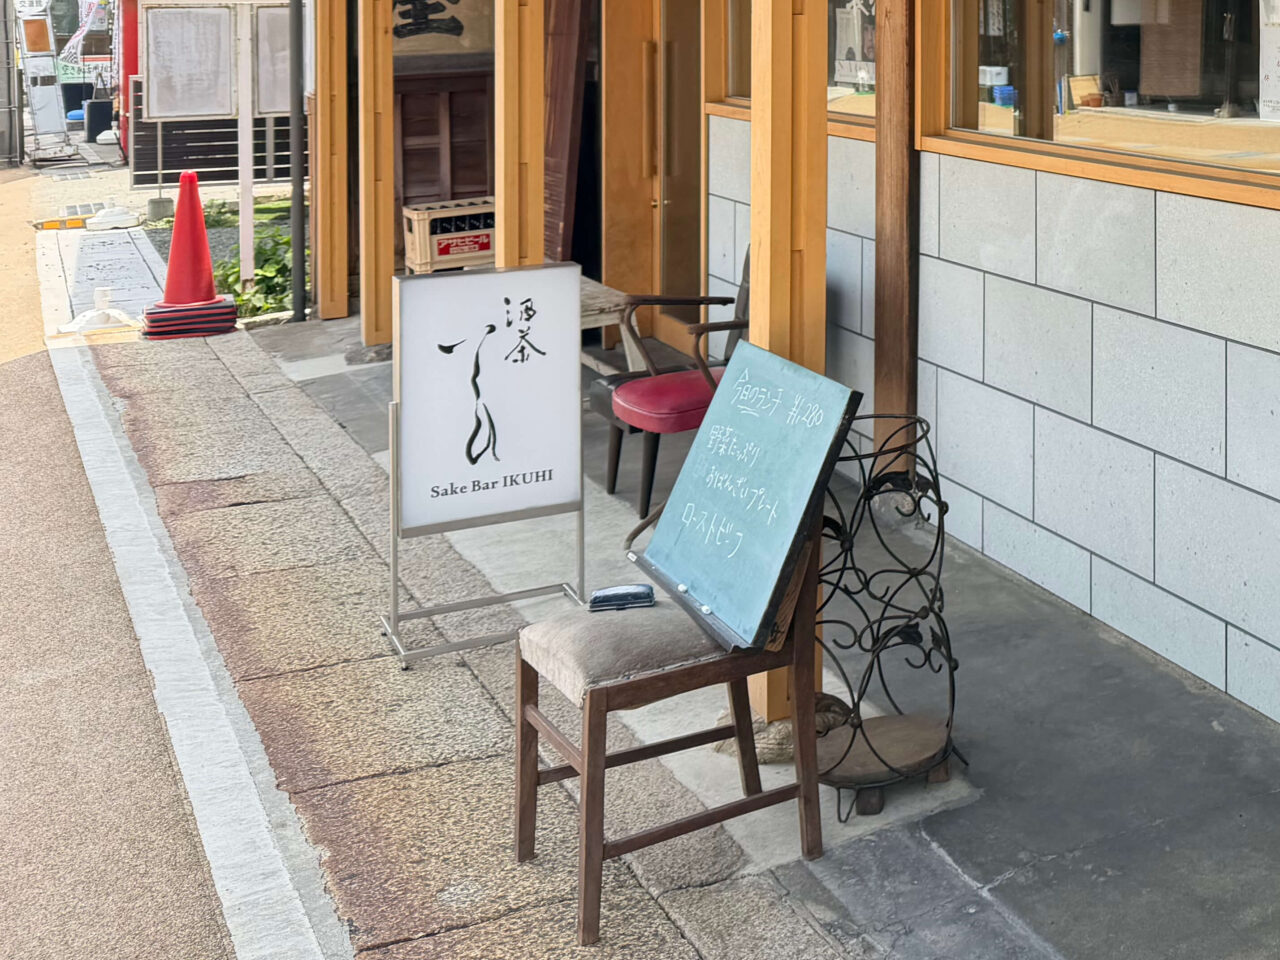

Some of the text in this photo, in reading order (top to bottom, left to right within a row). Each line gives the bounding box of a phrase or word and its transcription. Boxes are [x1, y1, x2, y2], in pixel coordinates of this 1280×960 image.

[438, 235, 489, 249] アサヒビール
[430, 468, 554, 499] Sake Bar IKUHI
[681, 502, 744, 559] ローストビーフ
